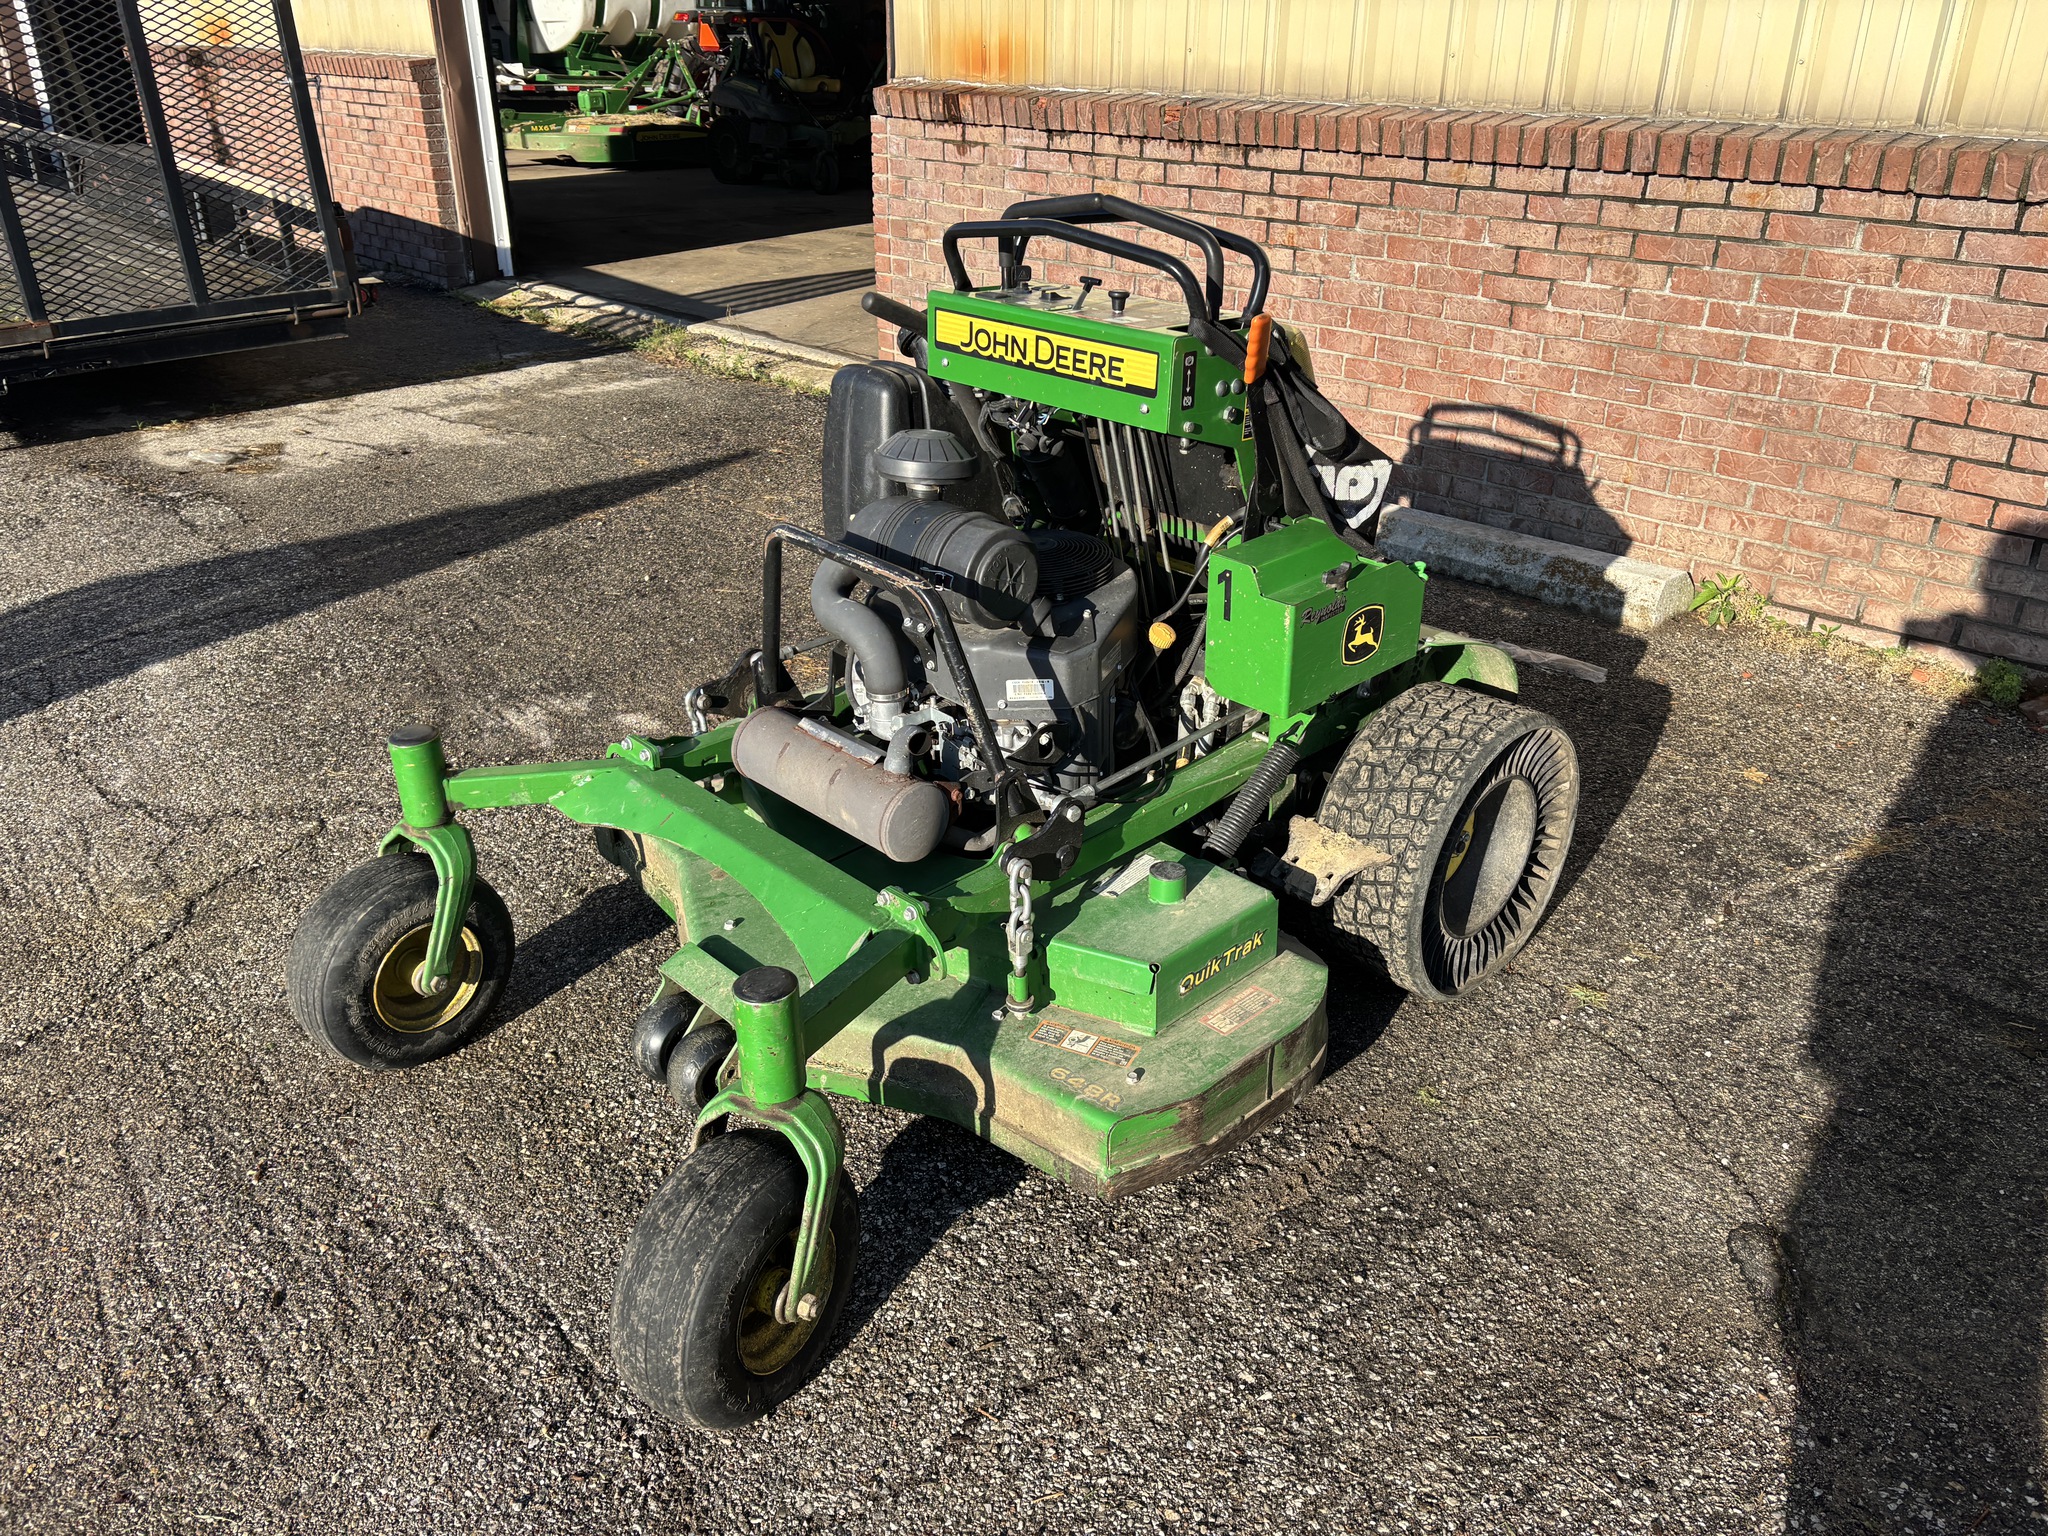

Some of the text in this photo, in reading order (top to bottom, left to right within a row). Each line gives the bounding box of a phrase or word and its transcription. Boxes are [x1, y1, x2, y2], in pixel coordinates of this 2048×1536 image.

[960, 321, 1125, 383] JOHN DEERE
[1217, 569, 1233, 622] 1
